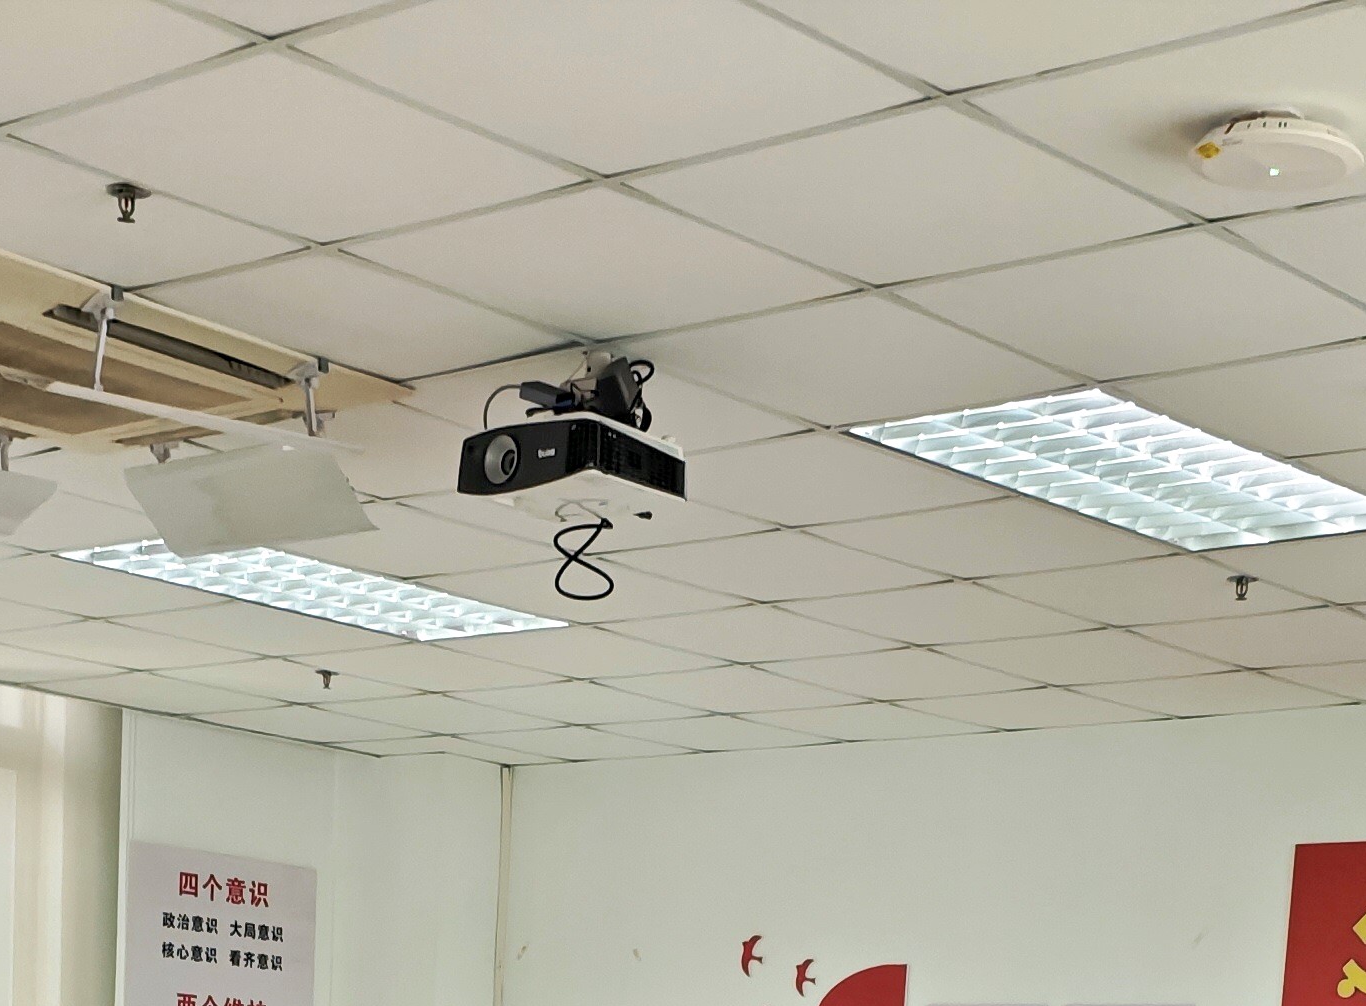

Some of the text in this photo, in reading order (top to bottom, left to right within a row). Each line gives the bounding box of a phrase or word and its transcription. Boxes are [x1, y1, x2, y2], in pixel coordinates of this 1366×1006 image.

[178, 871, 270, 908] 四个意识
[162, 911, 284, 942] 政治意识 大局意识
[161, 941, 283, 972] 核心意识 看齐意识
